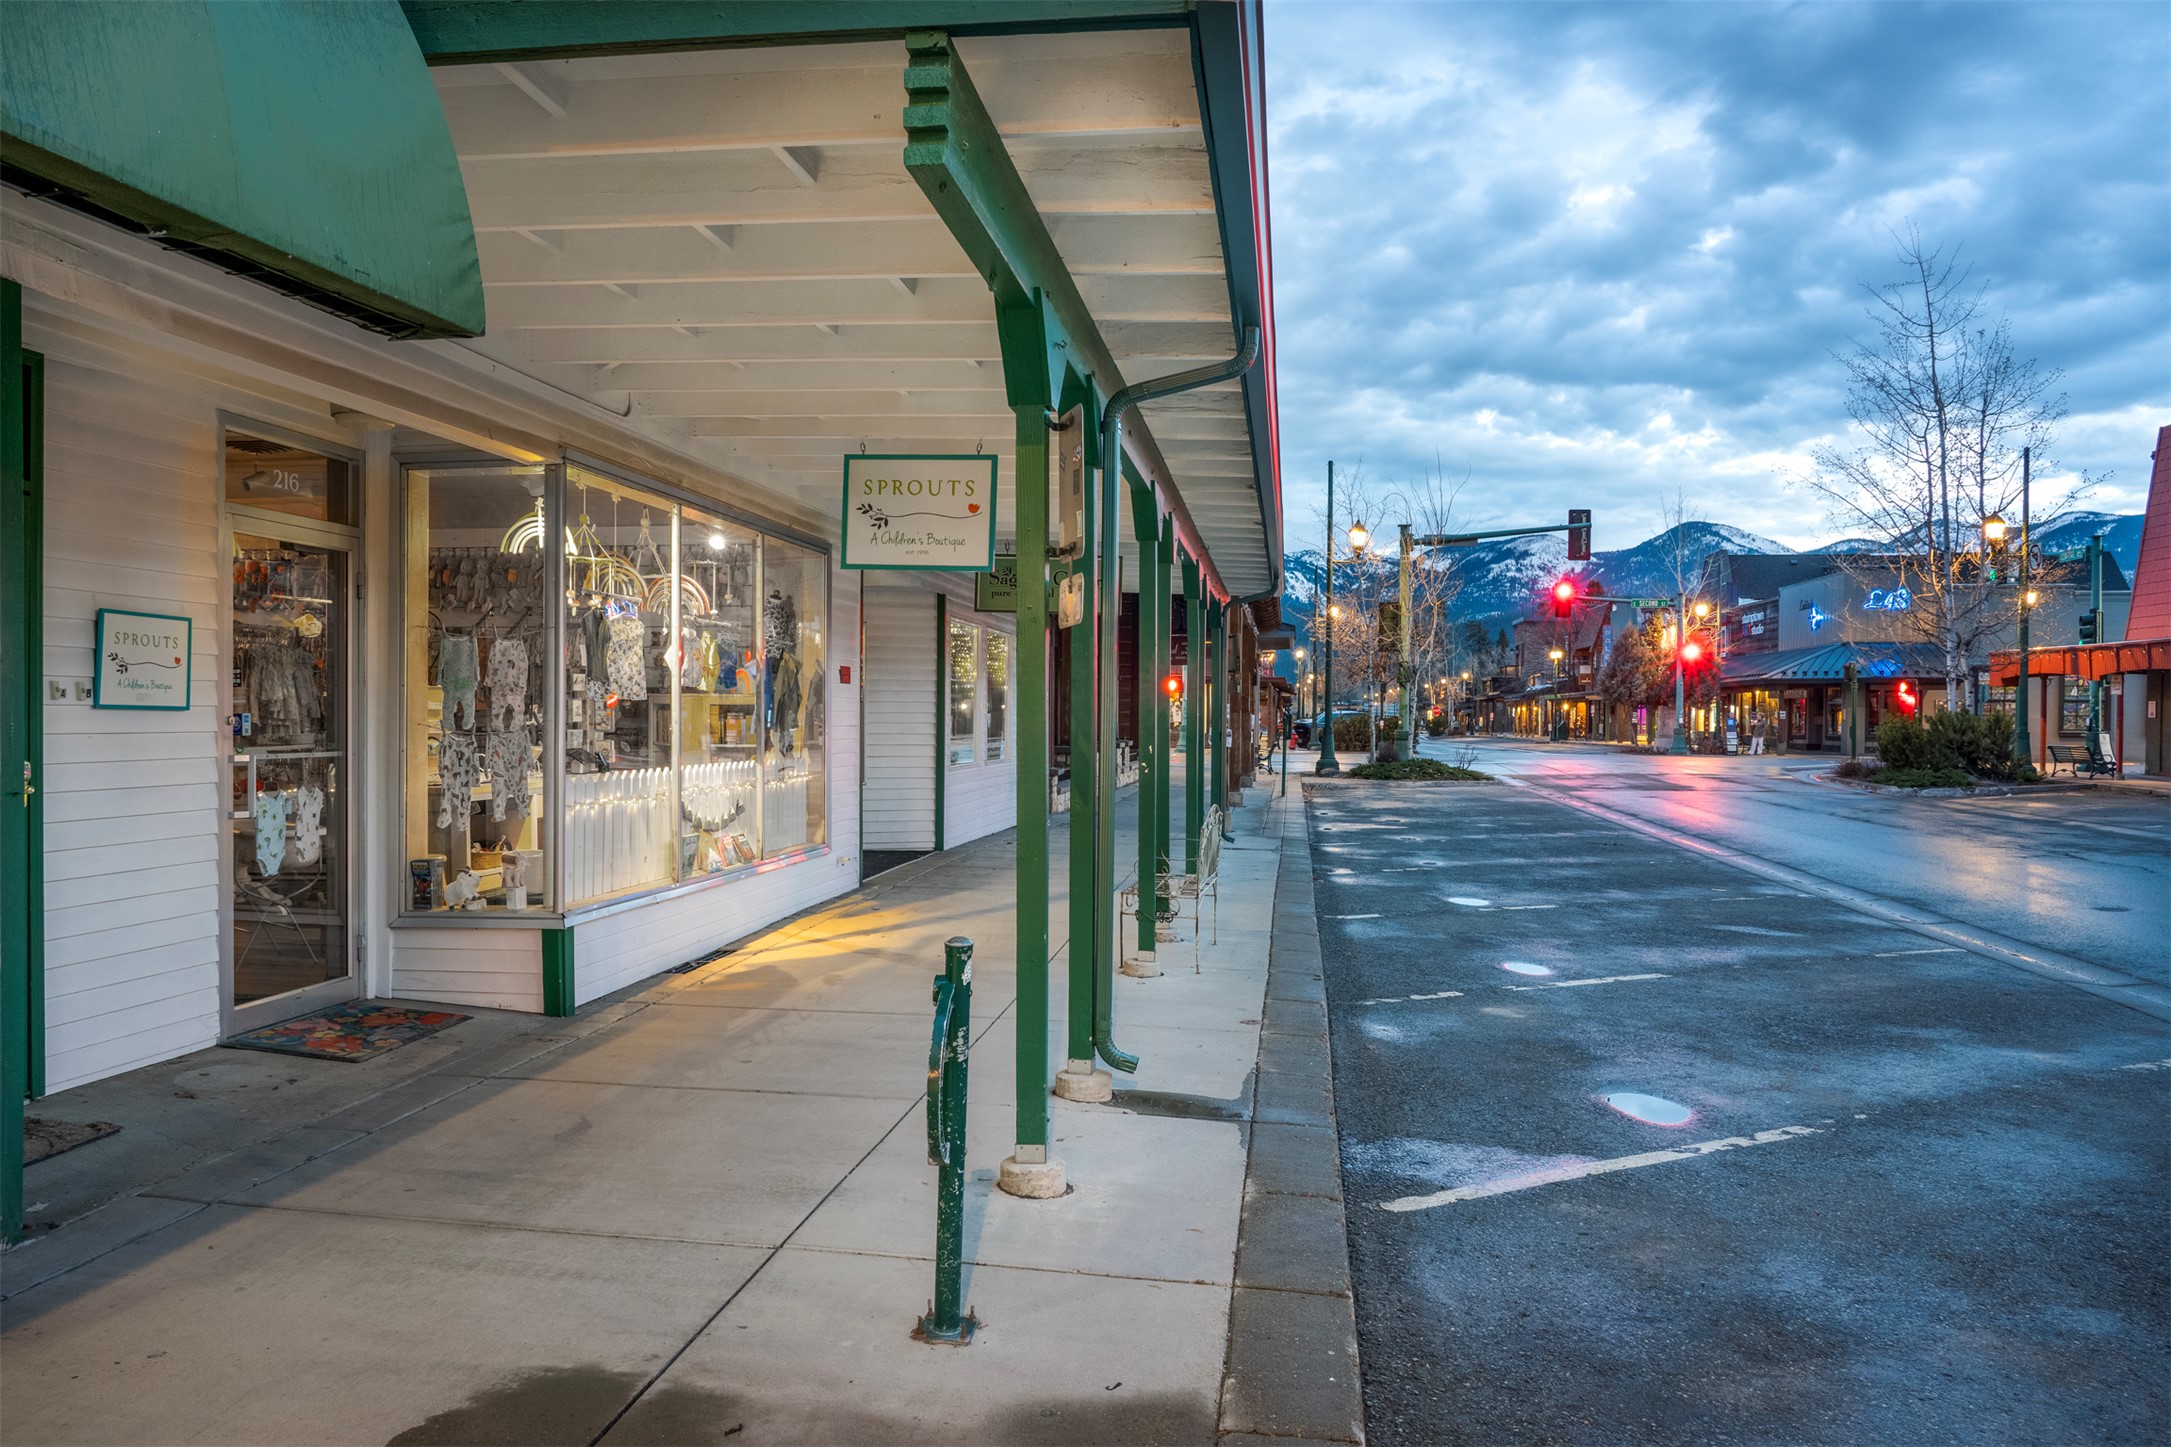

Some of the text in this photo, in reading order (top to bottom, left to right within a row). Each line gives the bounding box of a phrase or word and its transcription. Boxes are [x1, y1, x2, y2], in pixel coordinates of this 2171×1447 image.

[272, 469, 299, 492] 216
[863, 478, 975, 497] SPROUTS
[870, 530, 967, 552] A Children's Boutique
[988, 568, 1017, 590] Sag
[991, 591, 1012, 599] pure
[113, 631, 179, 650] SPROUTS
[60, 688, 67, 698] A
[86, 688, 92, 698] B
[123, 677, 149, 690] Children's
[150, 679, 173, 694] Boutique
